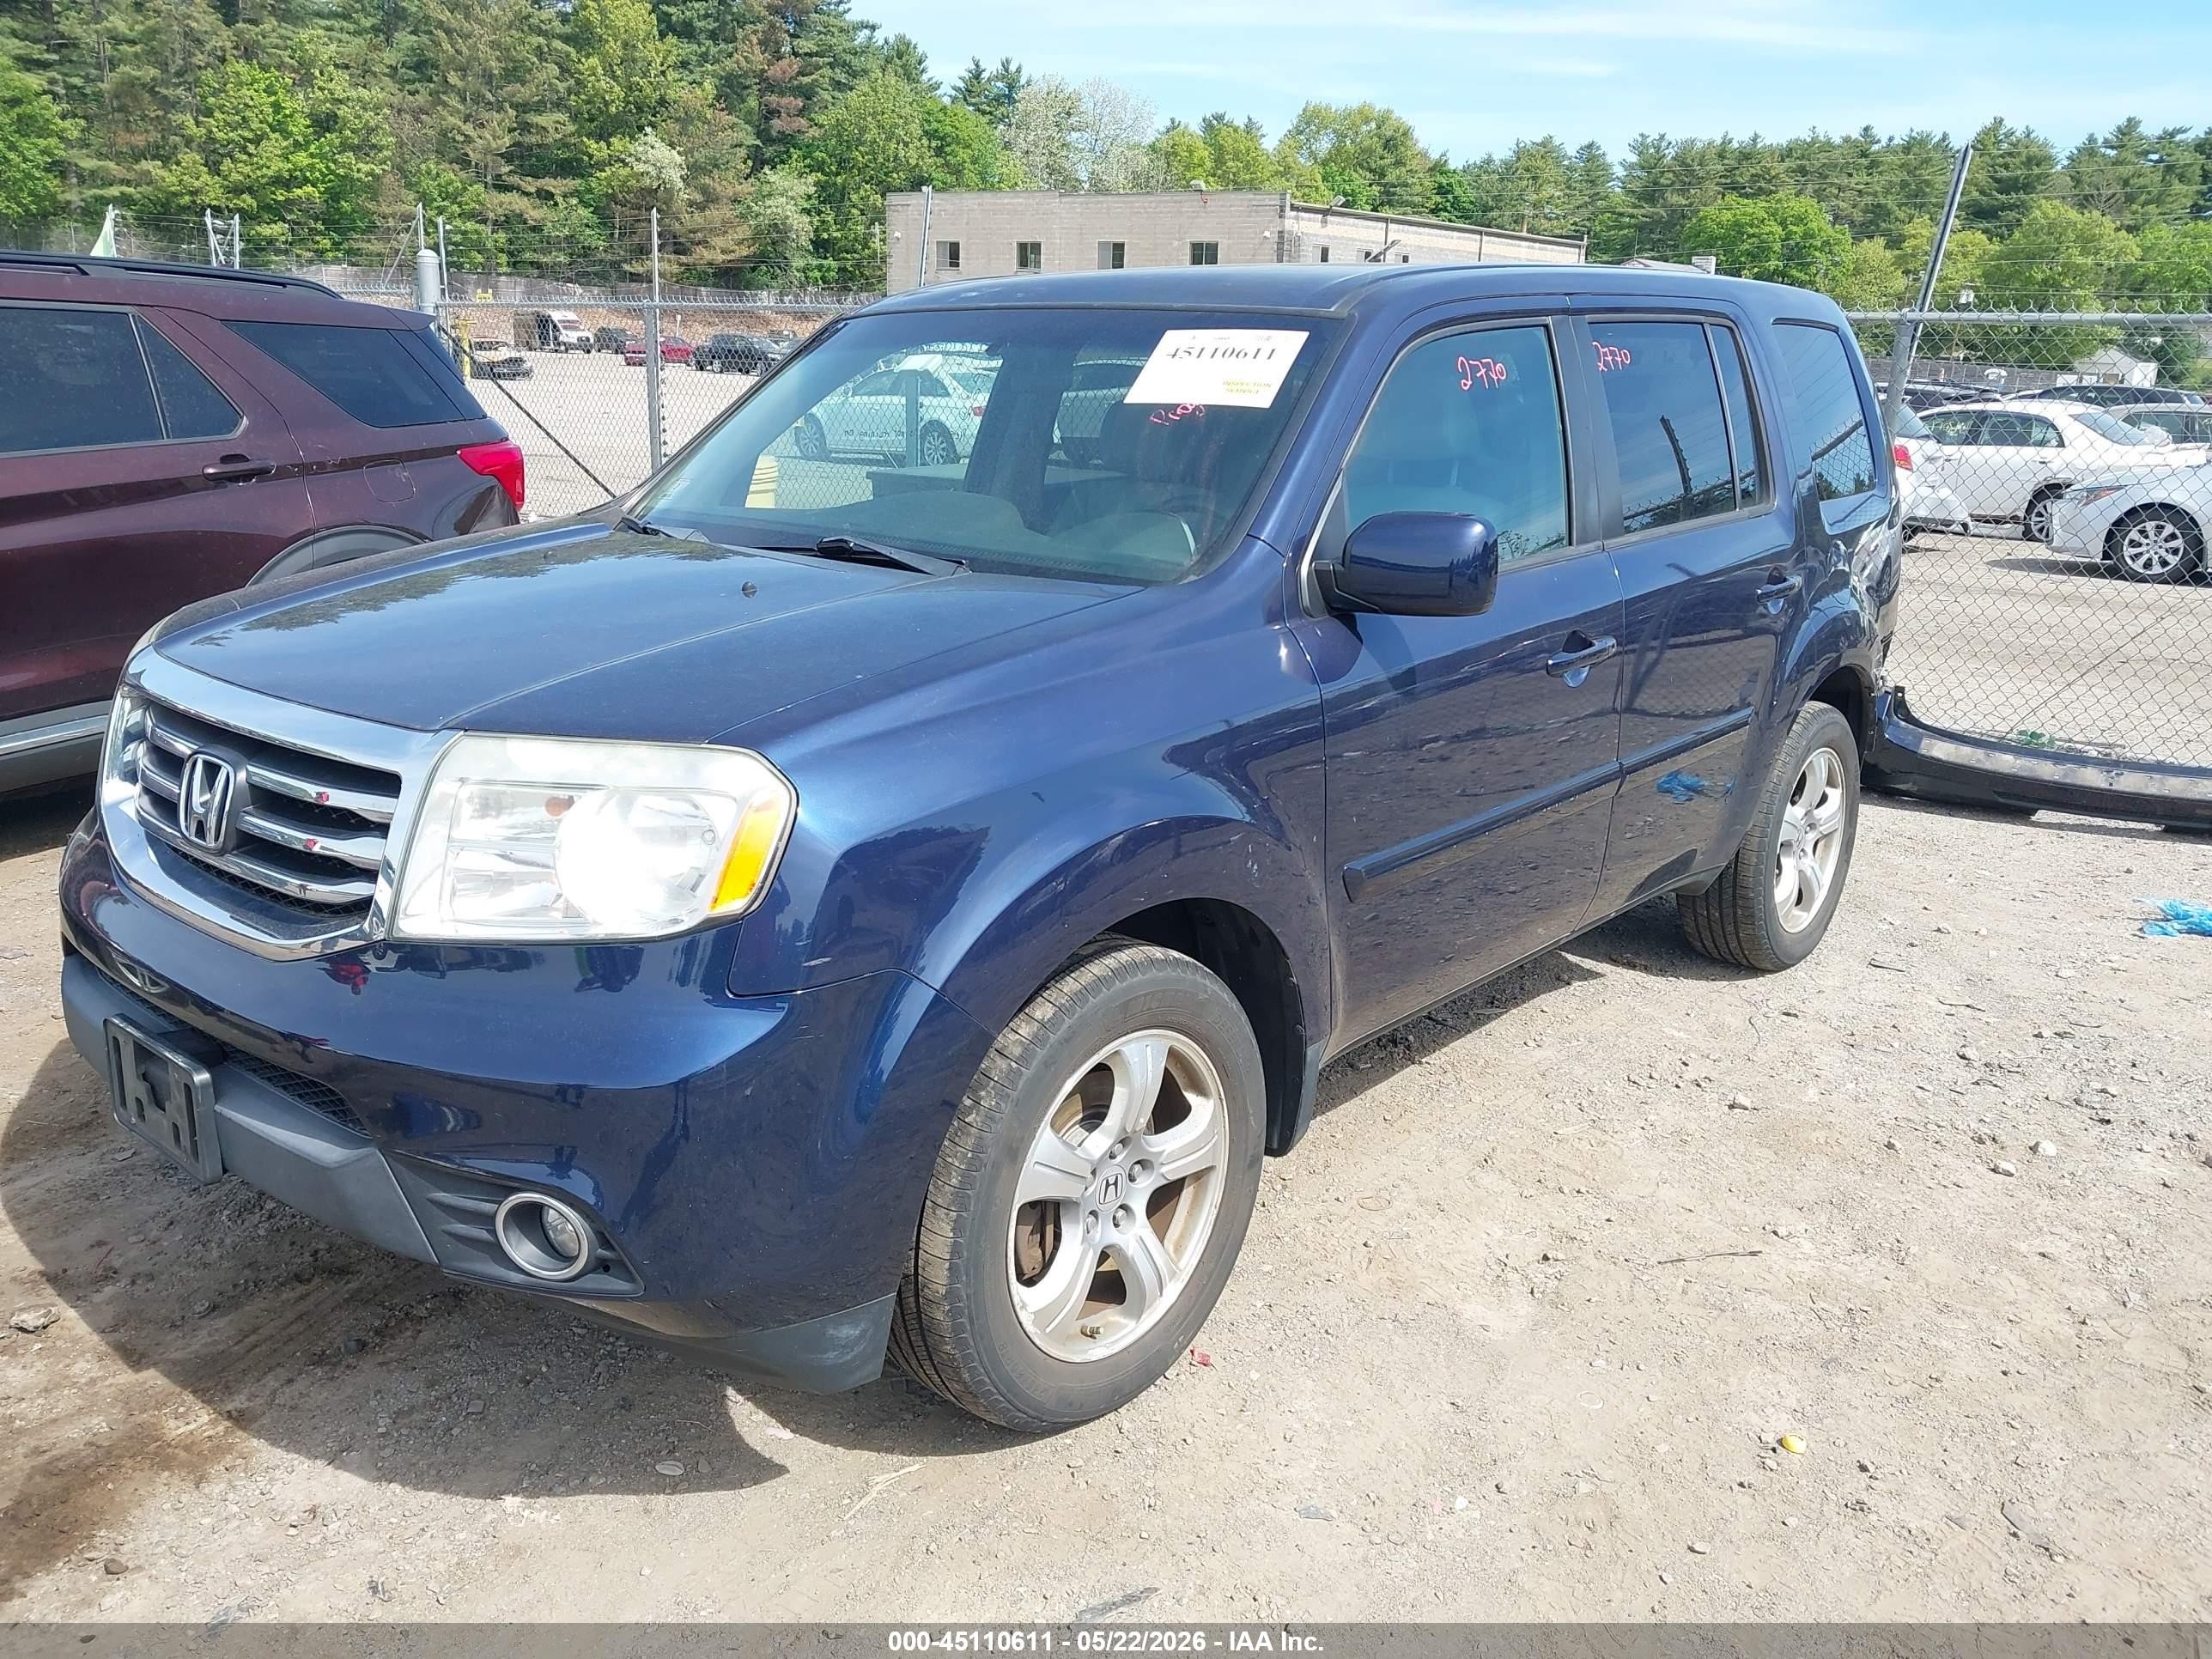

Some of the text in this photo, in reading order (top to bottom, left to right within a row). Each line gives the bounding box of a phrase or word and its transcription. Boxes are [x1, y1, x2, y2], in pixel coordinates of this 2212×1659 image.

[1166, 346, 1277, 361] 45110611
[1592, 341, 1632, 372] 2770
[1457, 356, 1507, 390] 2770
